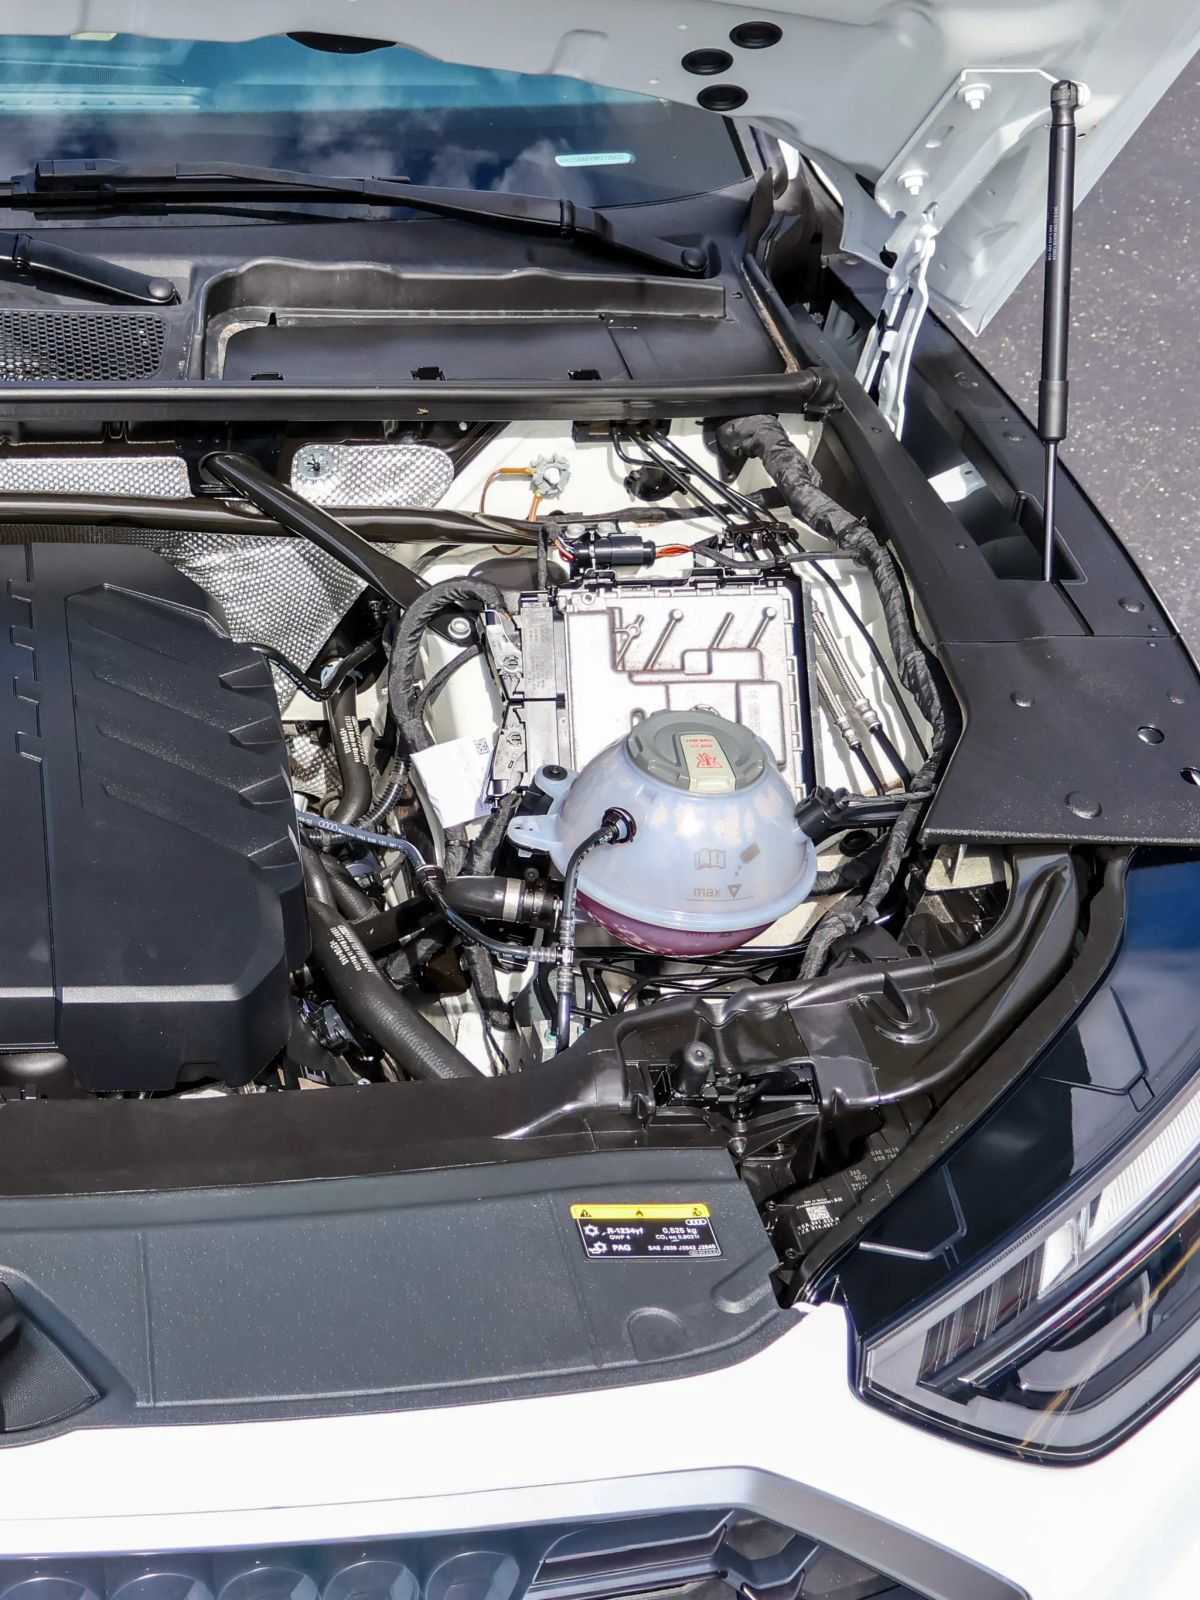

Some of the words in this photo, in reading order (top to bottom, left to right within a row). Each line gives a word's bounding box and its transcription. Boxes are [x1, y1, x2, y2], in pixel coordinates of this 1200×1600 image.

[693, 887, 721, 897] max
[606, 1227, 644, 1235] R-1234yf
[662, 1227, 685, 1235] 0,525
[687, 1227, 698, 1235] kg
[612, 1243, 632, 1251] PAG
